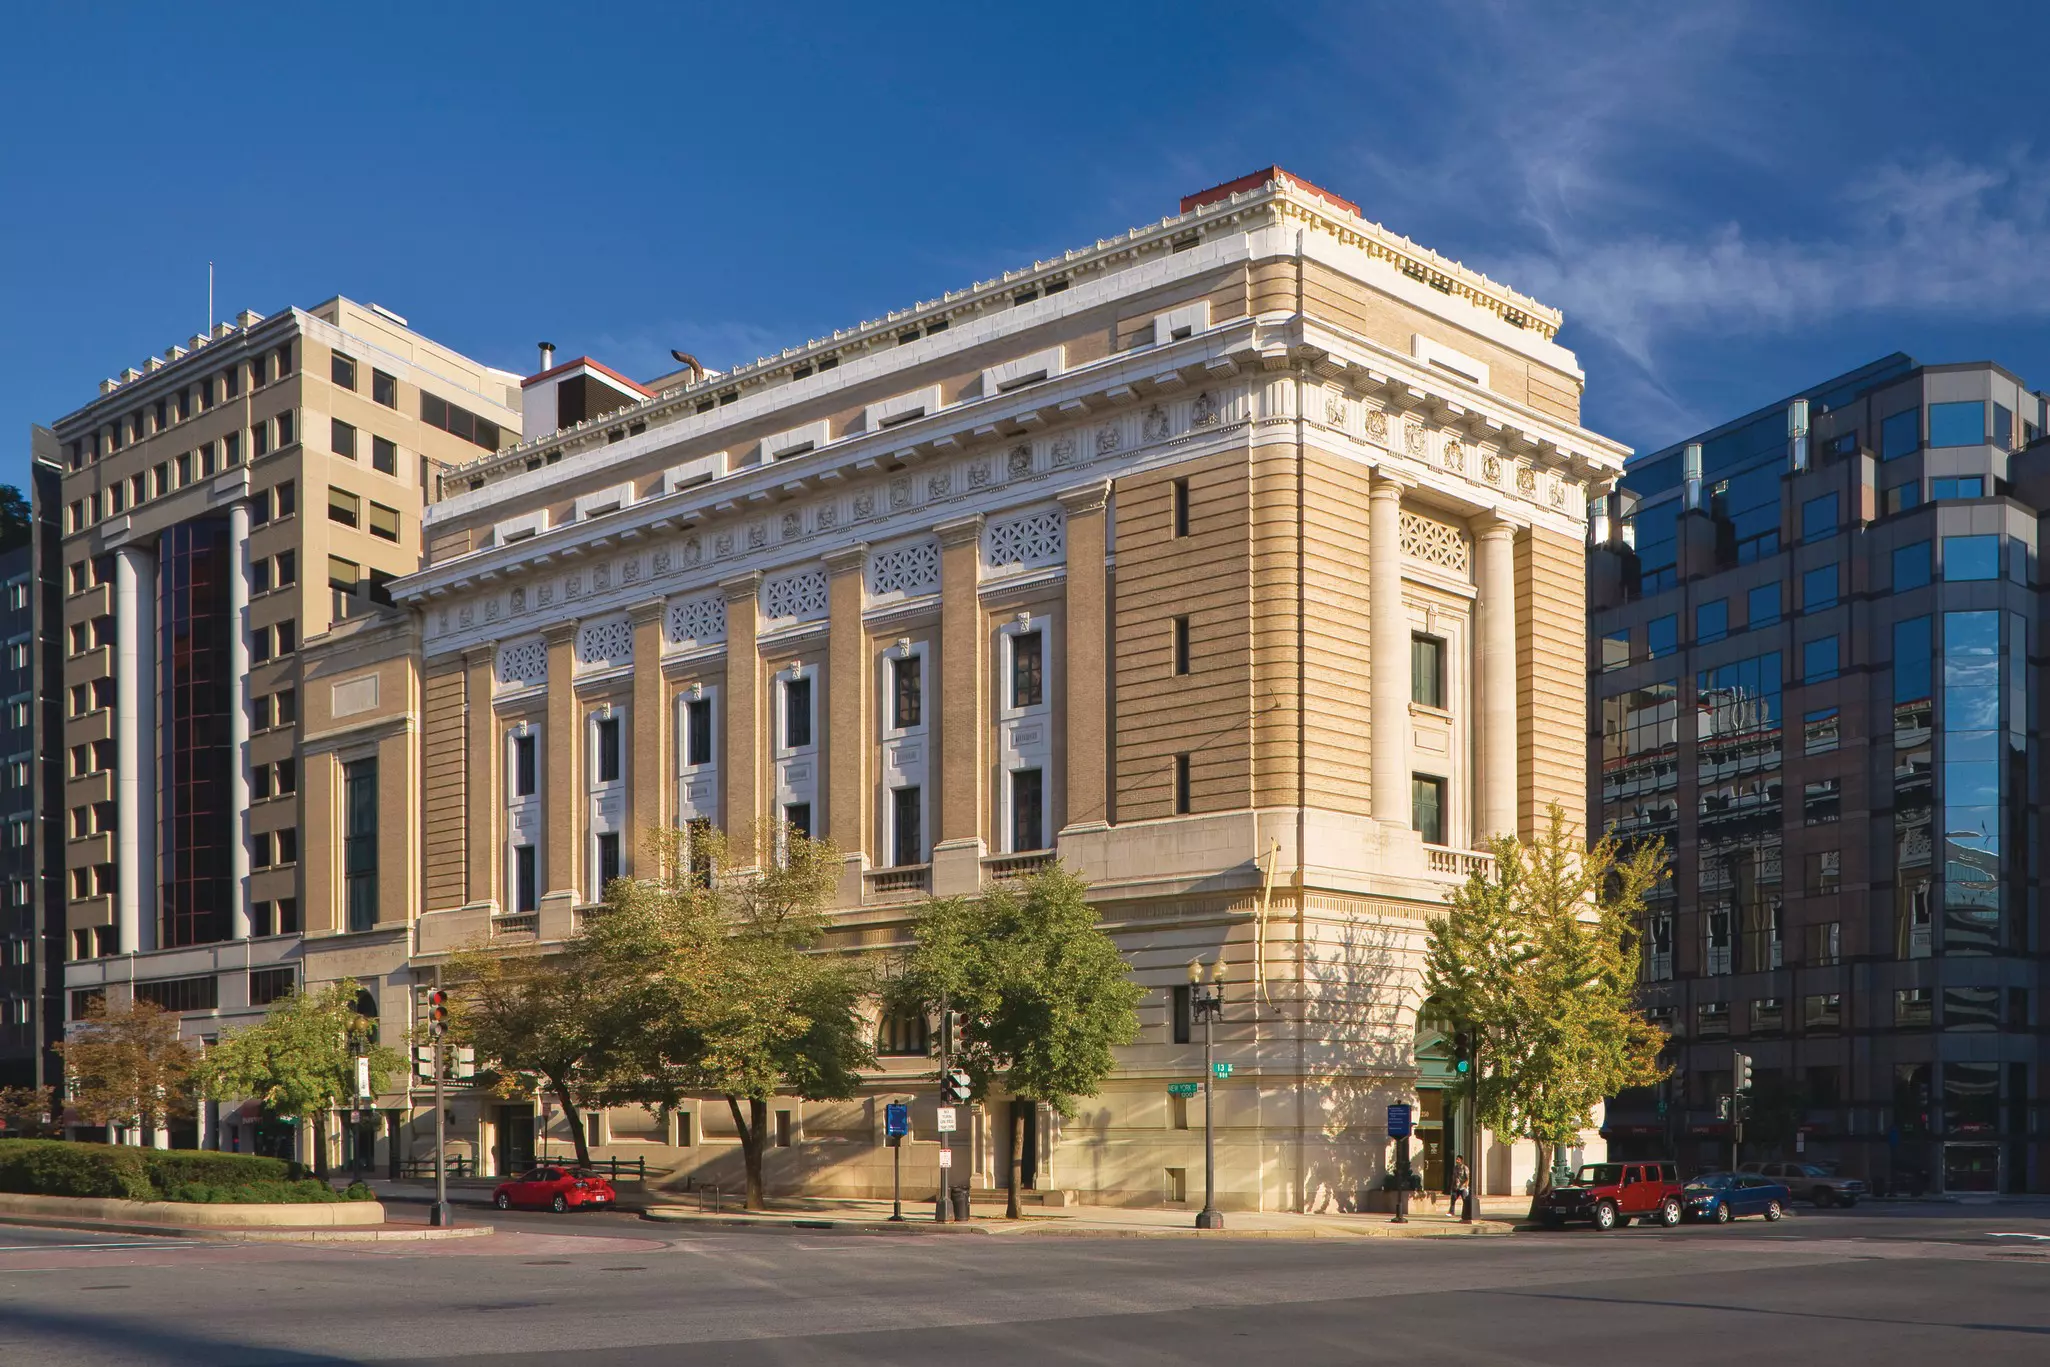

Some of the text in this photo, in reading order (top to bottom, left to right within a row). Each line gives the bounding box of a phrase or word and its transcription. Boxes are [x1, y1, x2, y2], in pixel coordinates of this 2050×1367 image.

[1217, 1064, 1225, 1072] 13
[1168, 1084, 1178, 1092] NEW
[1179, 1084, 1192, 1092] YORK
